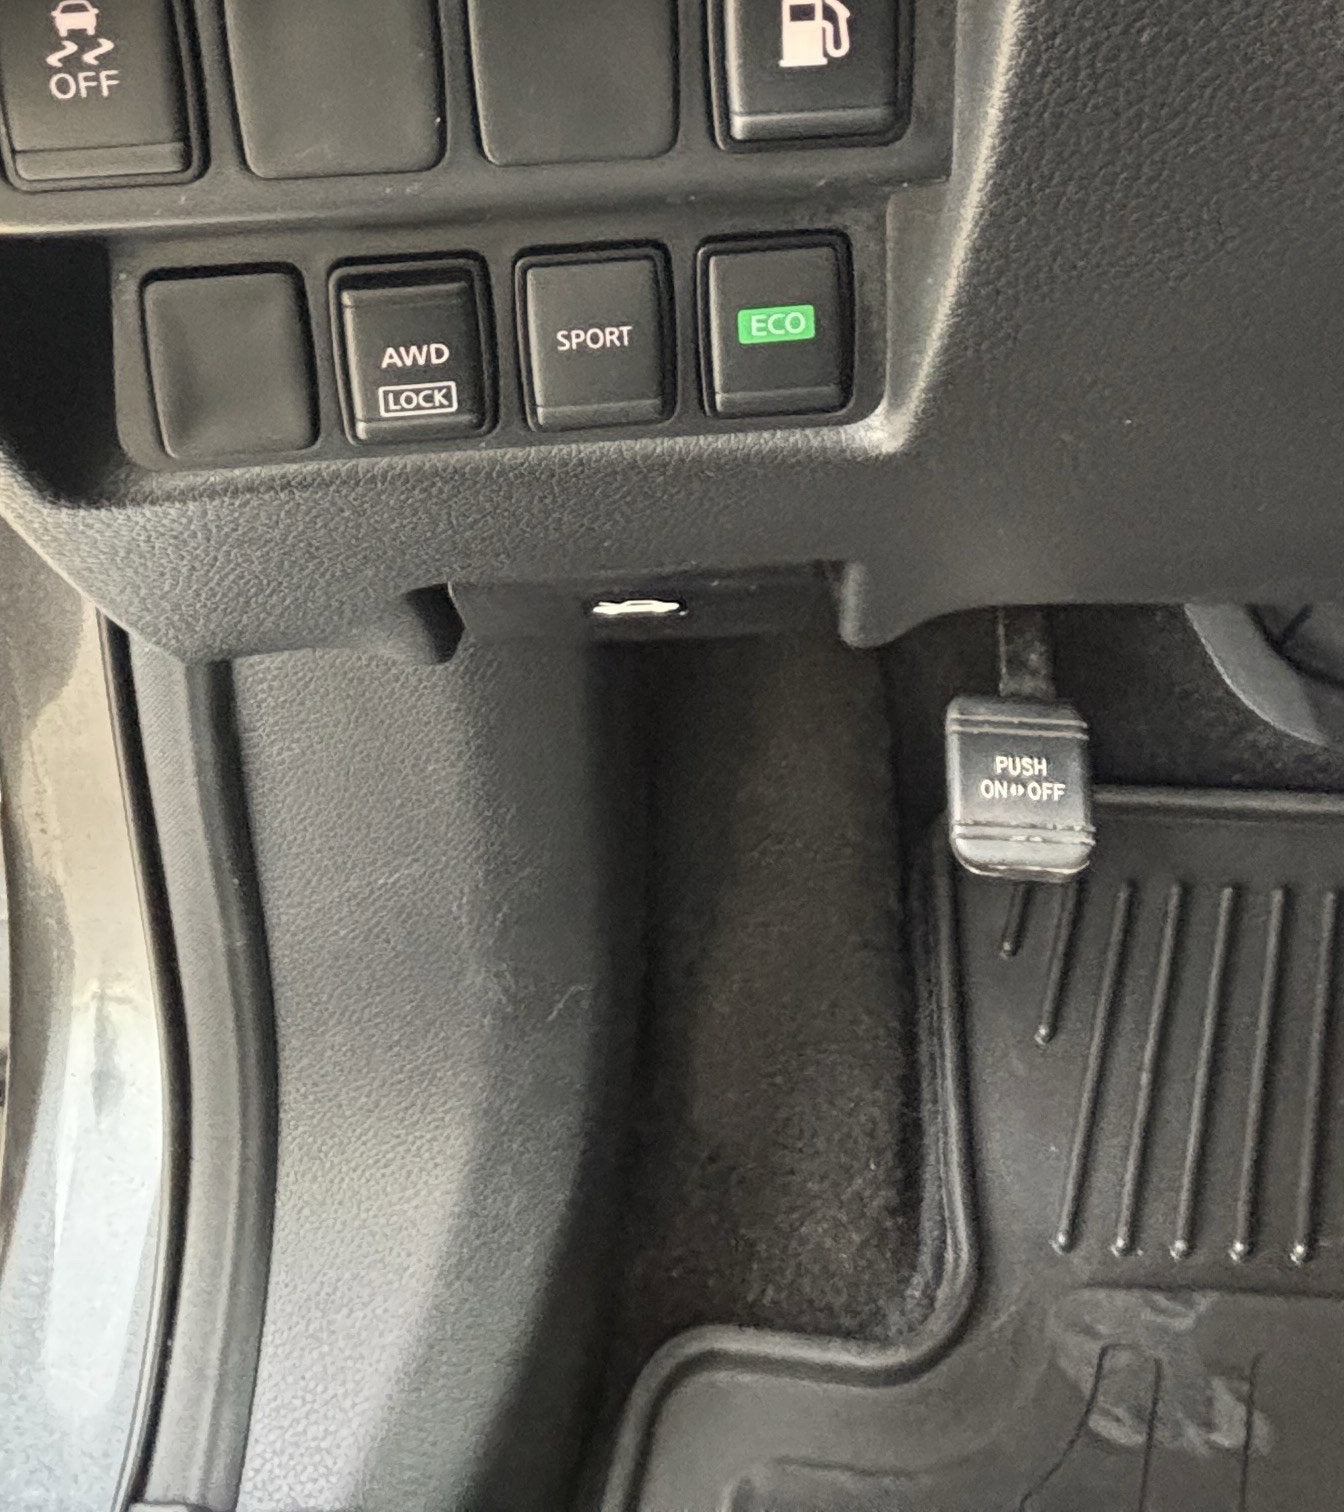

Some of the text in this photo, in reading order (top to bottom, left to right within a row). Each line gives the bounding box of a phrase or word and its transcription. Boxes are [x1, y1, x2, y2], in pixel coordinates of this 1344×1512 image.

[49, 68, 120, 100] OFF
[750, 311, 807, 338] ECO
[556, 325, 633, 351] SPORT
[381, 343, 450, 369] AWD
[387, 388, 450, 410] LOCK
[994, 755, 1048, 778] PUSH
